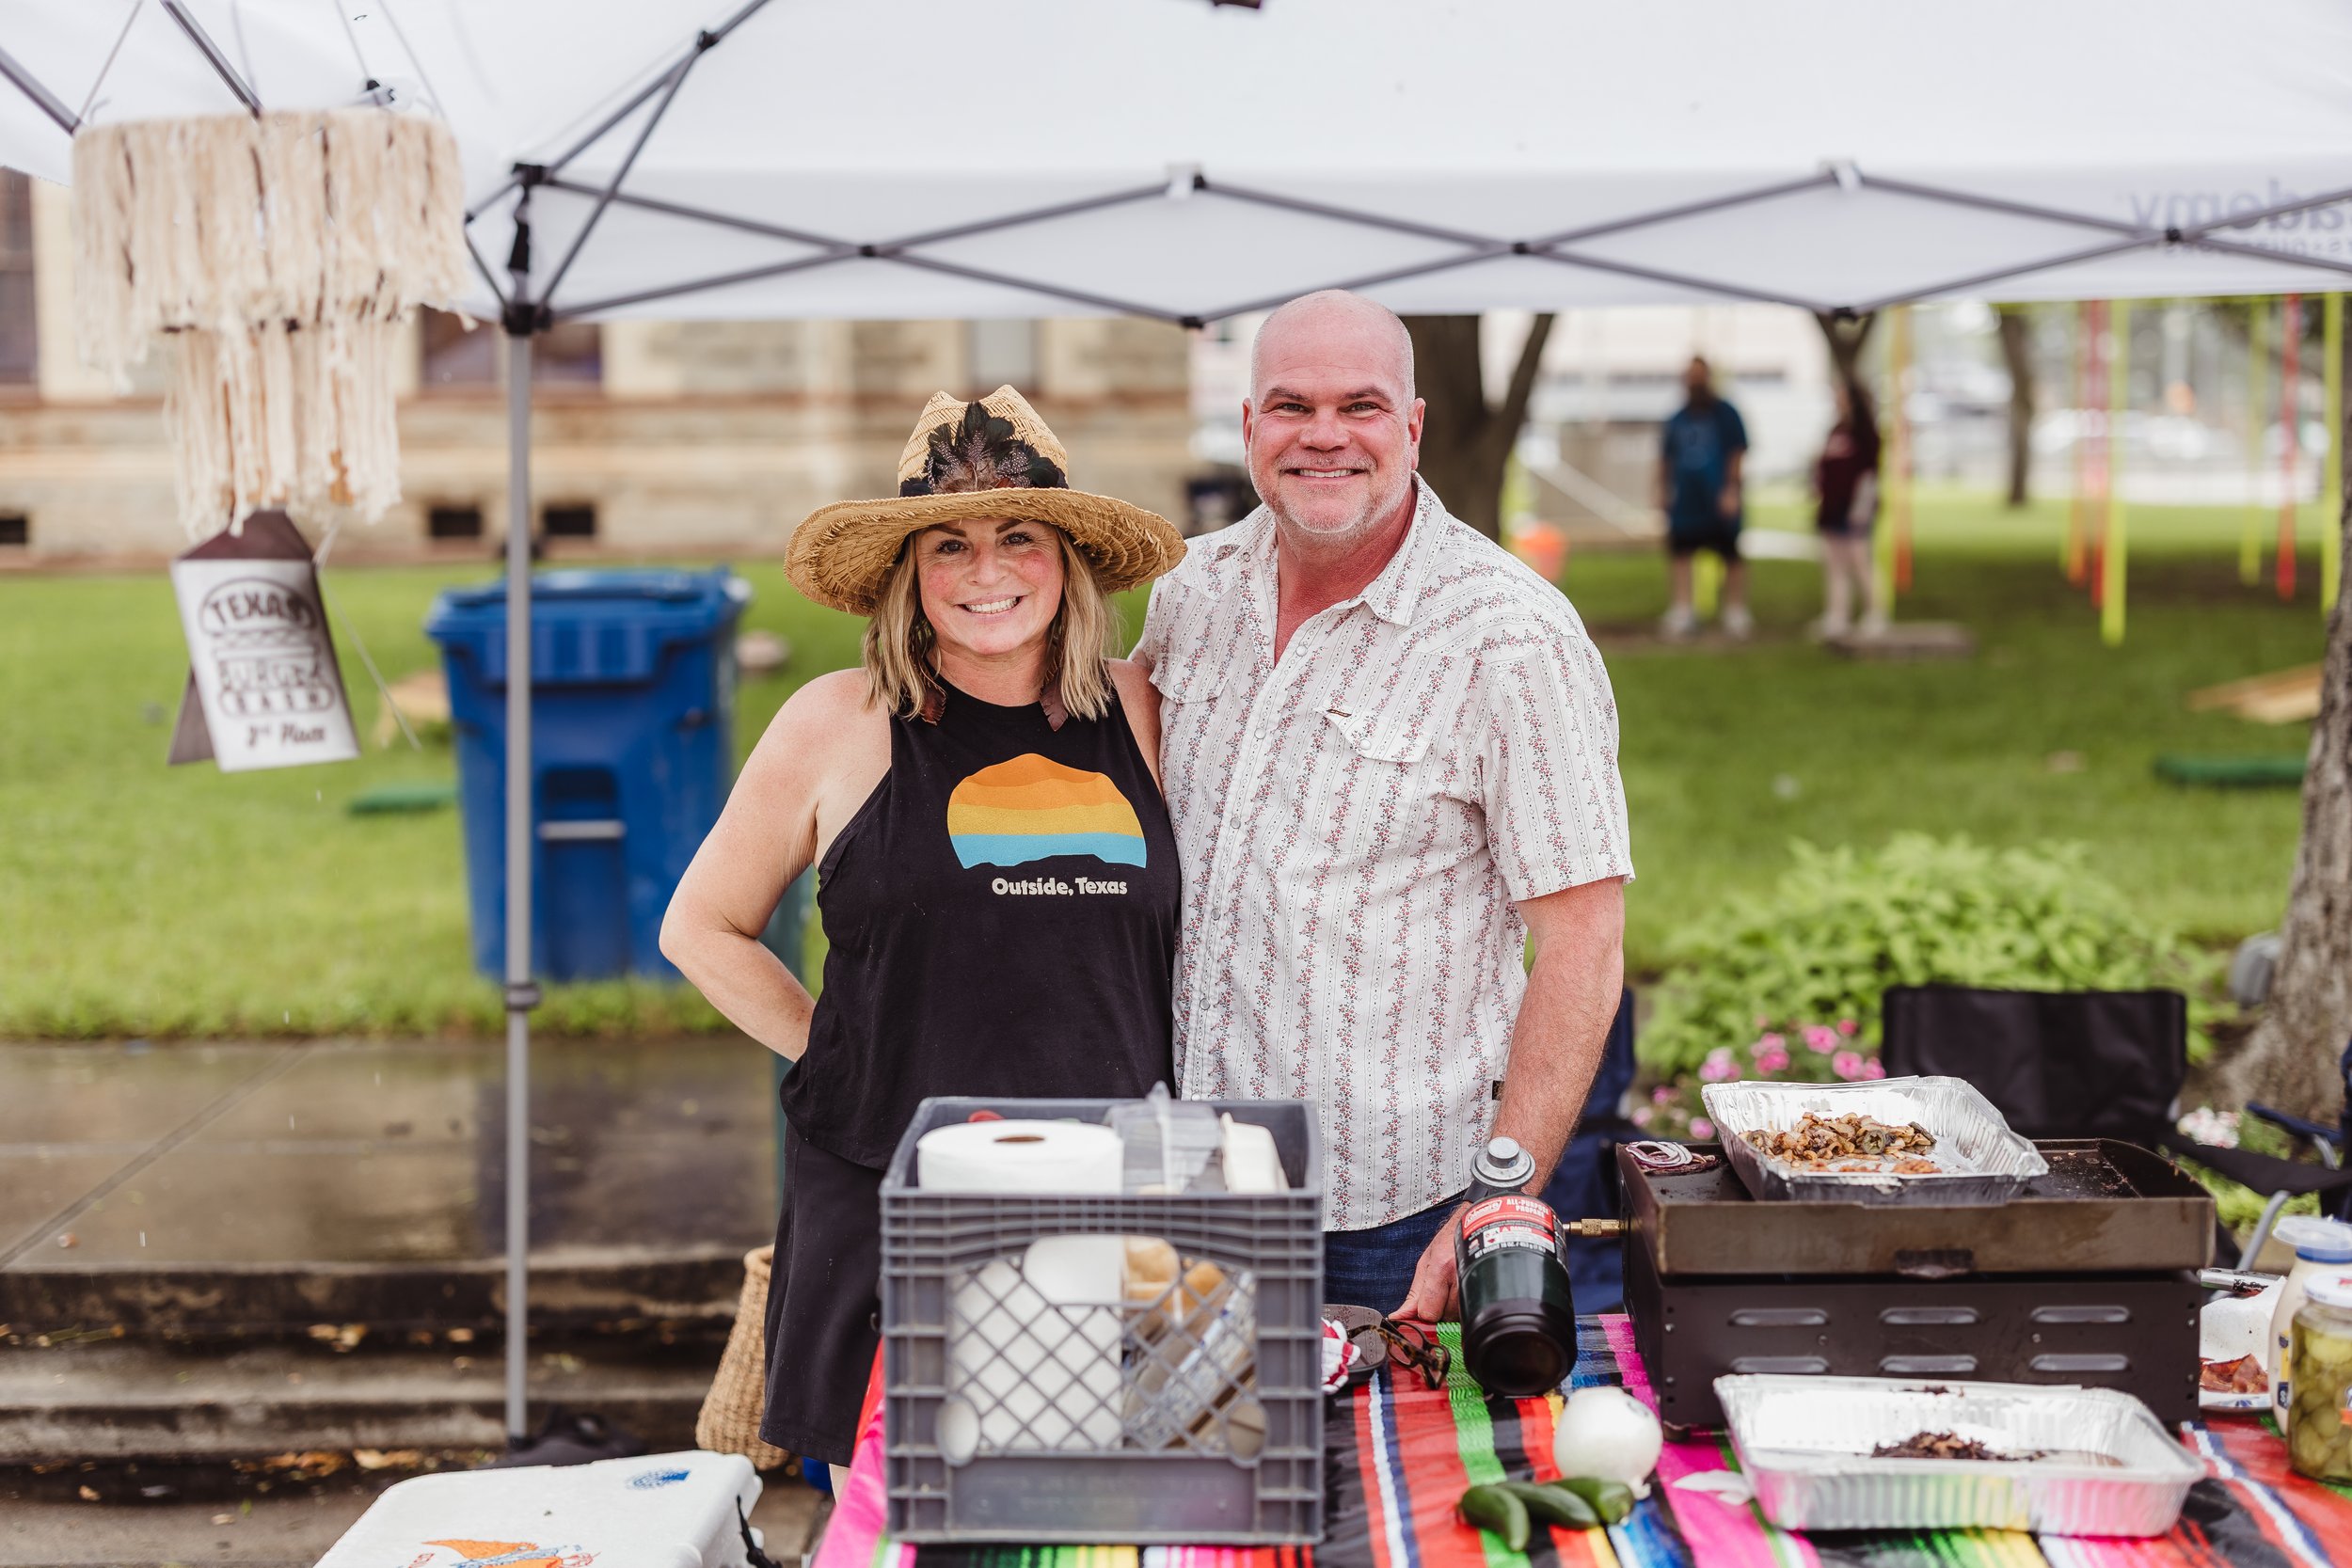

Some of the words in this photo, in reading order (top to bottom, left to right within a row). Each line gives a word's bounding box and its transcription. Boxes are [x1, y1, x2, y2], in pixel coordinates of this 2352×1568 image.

[209, 591, 304, 626] TEXAS
[992, 877, 1074, 896] Outside,
[1075, 877, 1128, 895] Texas
[1506, 1197, 1549, 1215] ALL-PURPOSE
[1515, 1205, 1546, 1219] PROPANE
